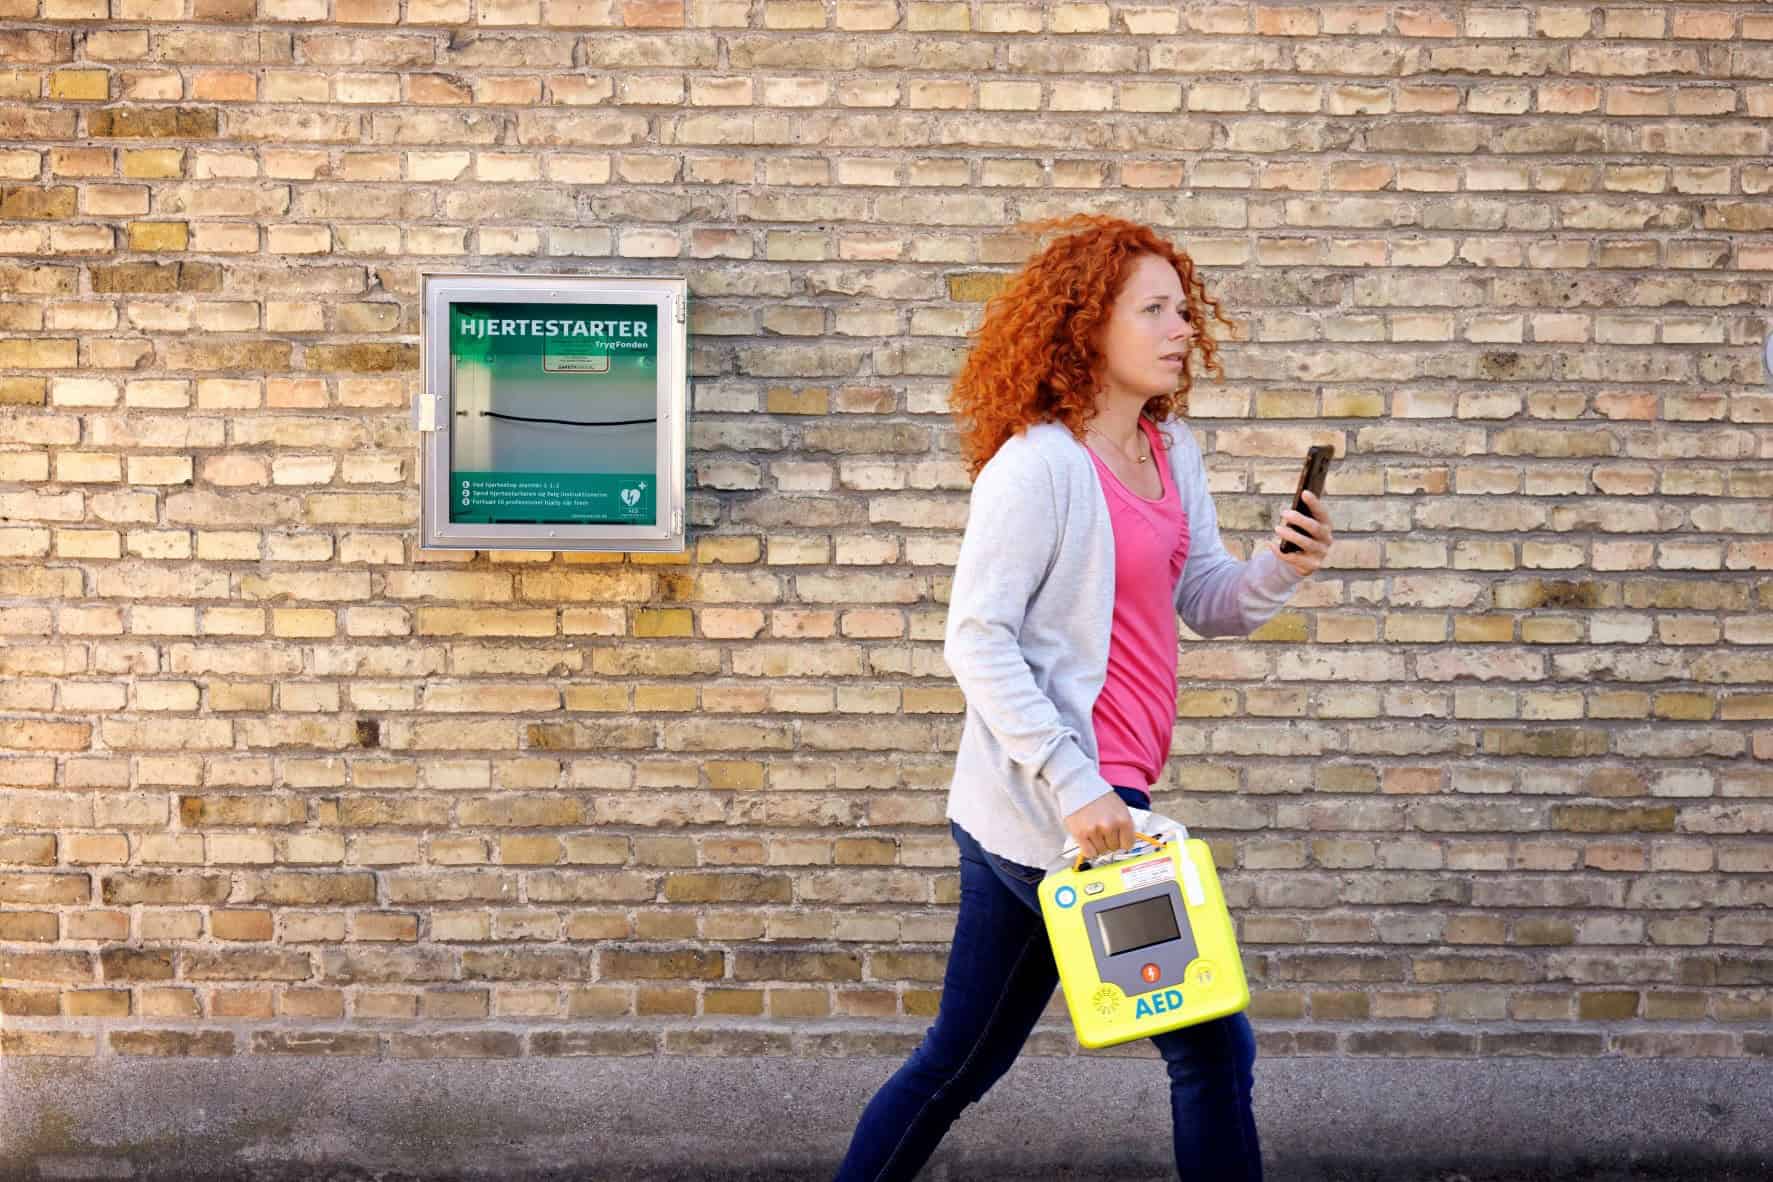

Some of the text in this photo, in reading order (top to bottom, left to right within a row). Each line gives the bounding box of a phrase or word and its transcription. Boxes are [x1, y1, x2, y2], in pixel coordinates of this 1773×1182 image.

[460, 319, 648, 338] HJERTESTARTER
[595, 341, 648, 350] TrygFonden
[1136, 990, 1183, 1020] AED
